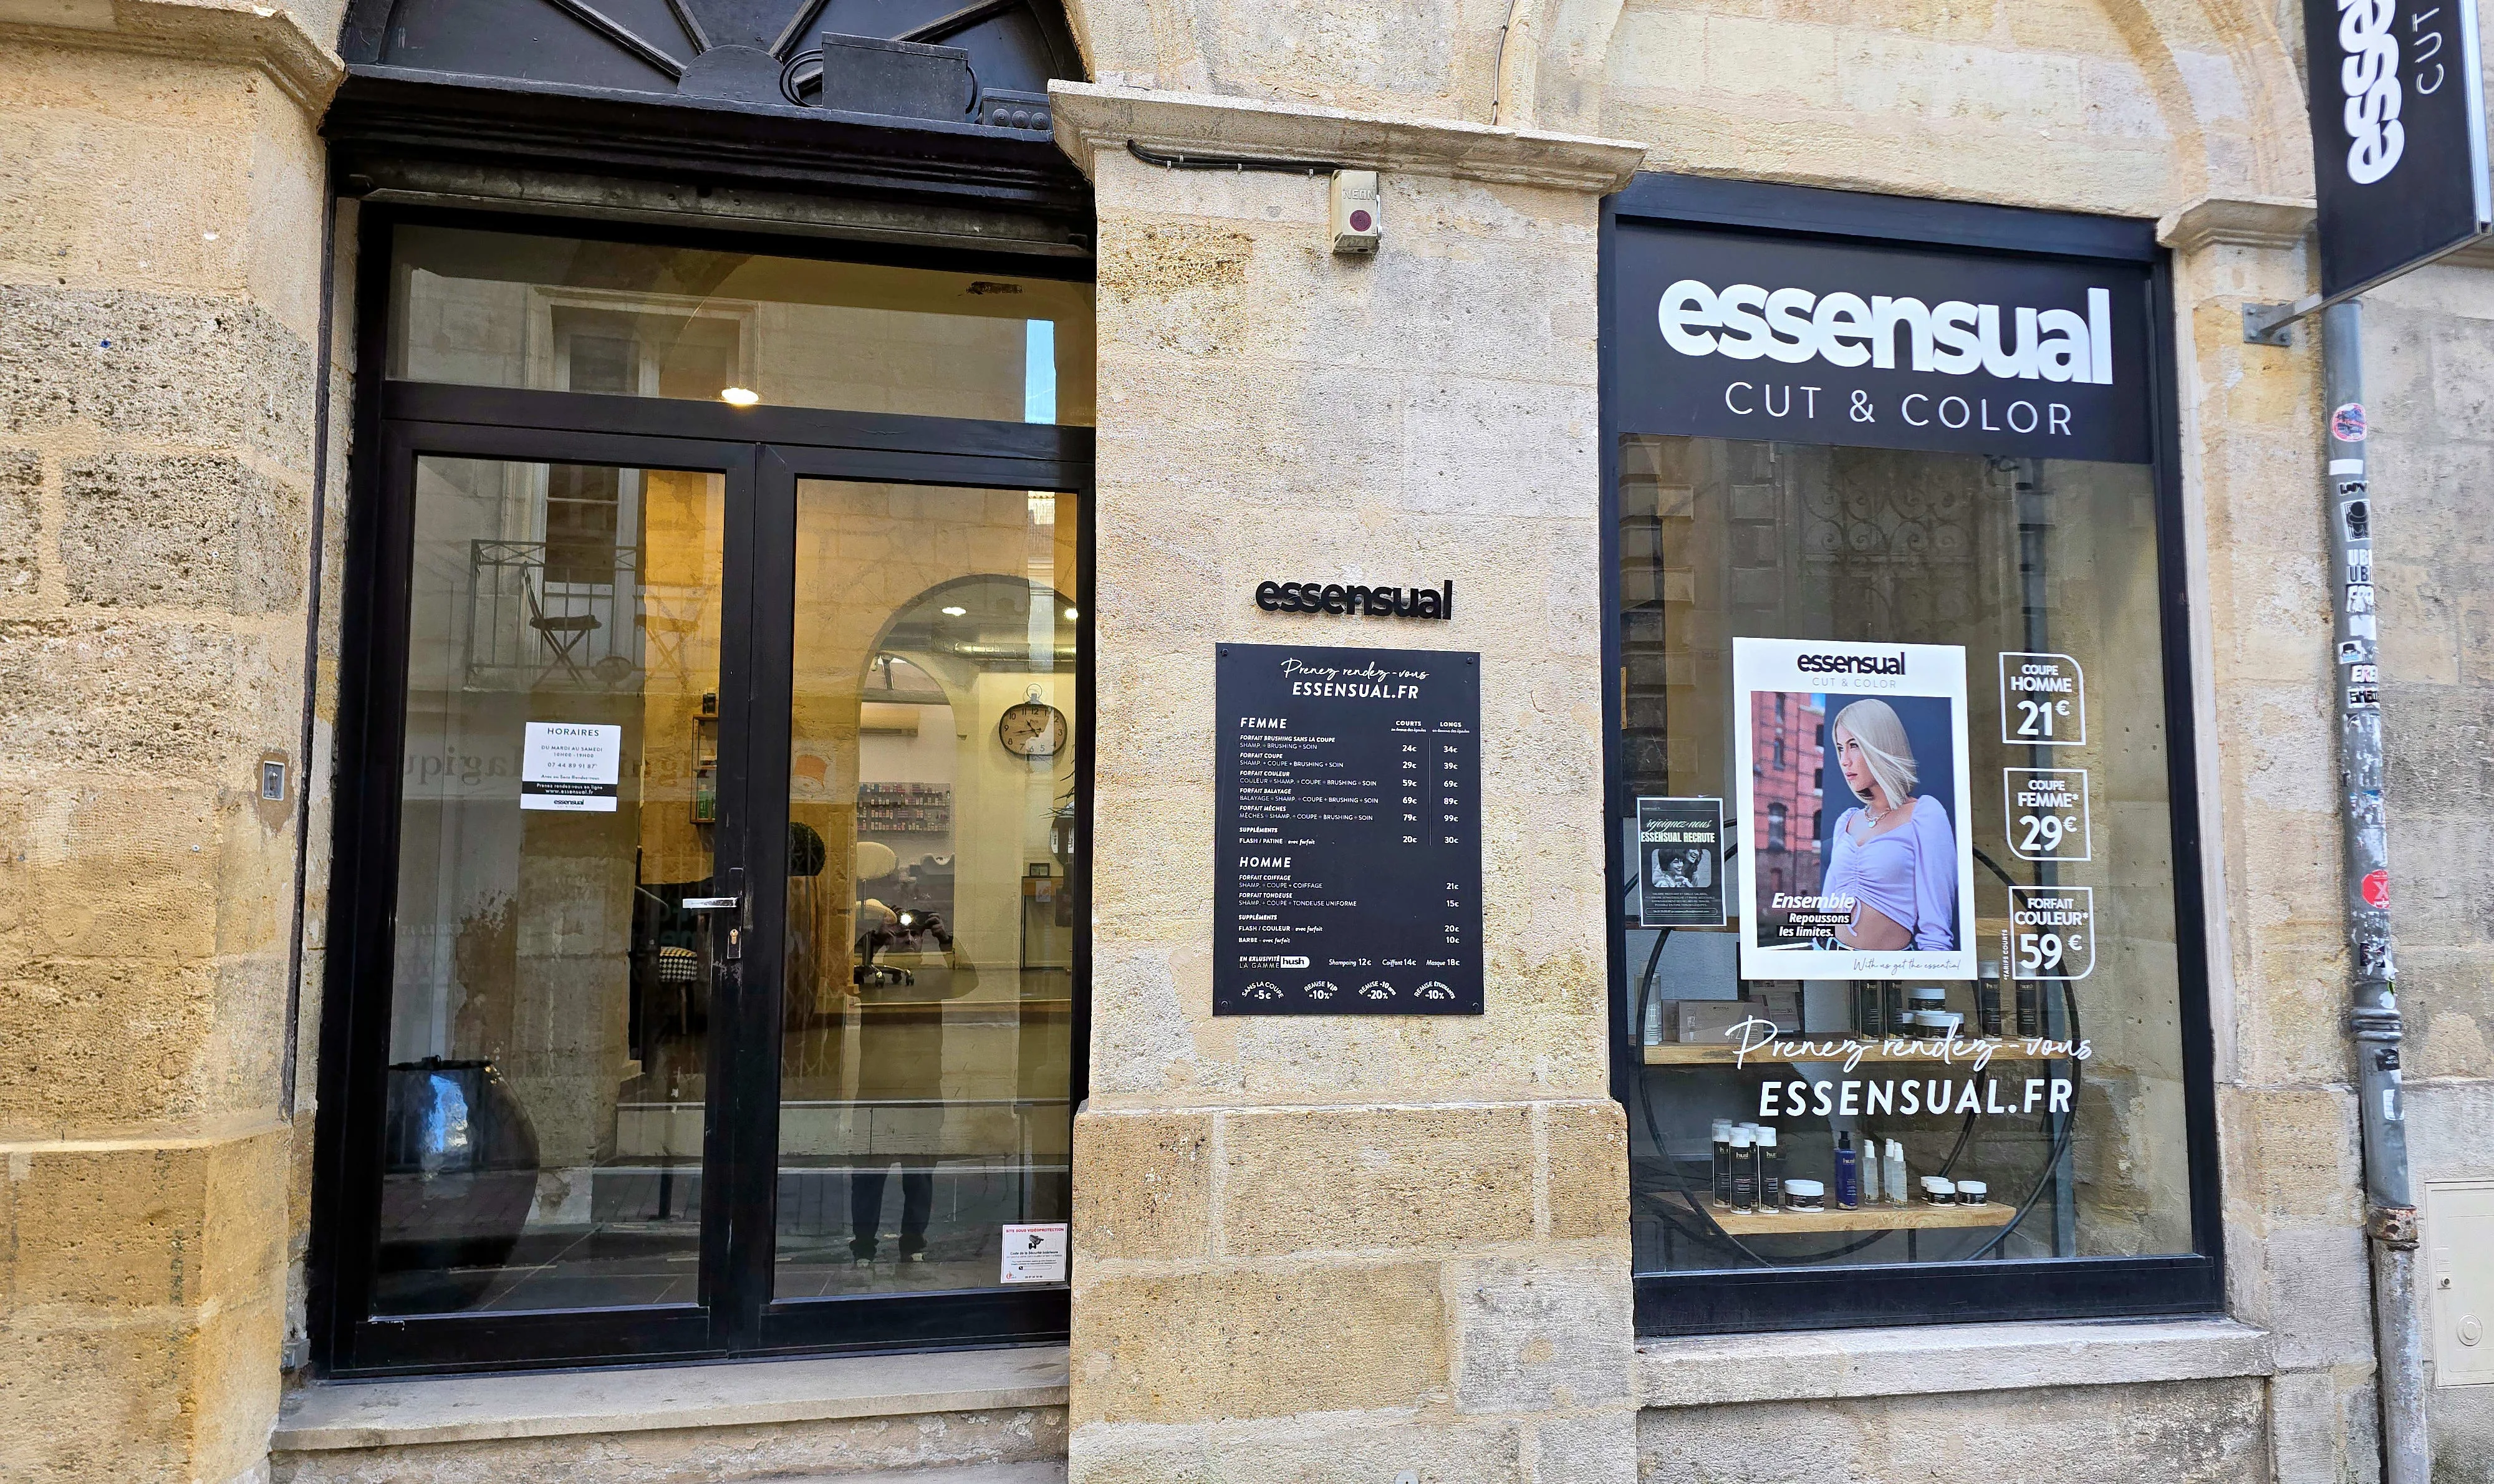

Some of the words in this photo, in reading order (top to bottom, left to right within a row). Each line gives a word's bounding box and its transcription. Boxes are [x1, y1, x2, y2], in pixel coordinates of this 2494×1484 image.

[2410, 7, 2444, 95] CUT
[1342, 189, 1376, 200] NEON
[1658, 279, 2113, 385] essensual
[1725, 382, 1822, 419] CUT
[1849, 390, 1875, 423] &
[1900, 393, 2073, 436] COLOR
[1255, 579, 1453, 620] essensual
[1281, 657, 1339, 680] Prenez
[1342, 662, 1429, 682] rendez-vous
[1797, 651, 1906, 675] essensual
[2021, 664, 2058, 676] COUPE
[1812, 677, 1836, 687] CUT
[1854, 678, 1897, 688] COLOR
[2011, 677, 2073, 693] HOMME
[1293, 682, 1418, 699] ESSENSUAL.FR
[1240, 718, 1287, 729] FEMME
[547, 728, 599, 736] HORAIRES
[2028, 780, 2065, 791] COUPE
[1641, 832, 1682, 842] ESSENSUAL
[1683, 832, 1715, 842] RECRUTE
[1239, 857, 1291, 868] HOMME
[1771, 892, 1856, 909] Ensemble
[2028, 898, 2074, 909] FORFAIT
[1789, 913, 1849, 925] Repoussons
[1779, 927, 1794, 937] les
[1796, 926, 1834, 937] limites.
[1241, 983, 1256, 997] SANS
[1264, 981, 1284, 998] COUPE
[1304, 980, 1326, 992] REMISE
[1327, 981, 1338, 992] VIP
[1359, 981, 1379, 995] REMISE
[1414, 981, 1433, 997] REMISE
[1725, 1014, 1875, 1072] Prenez
[1882, 1015, 2094, 1072] rendez-vous
[1759, 1078, 2073, 1117] ESSENSUAL.FR
